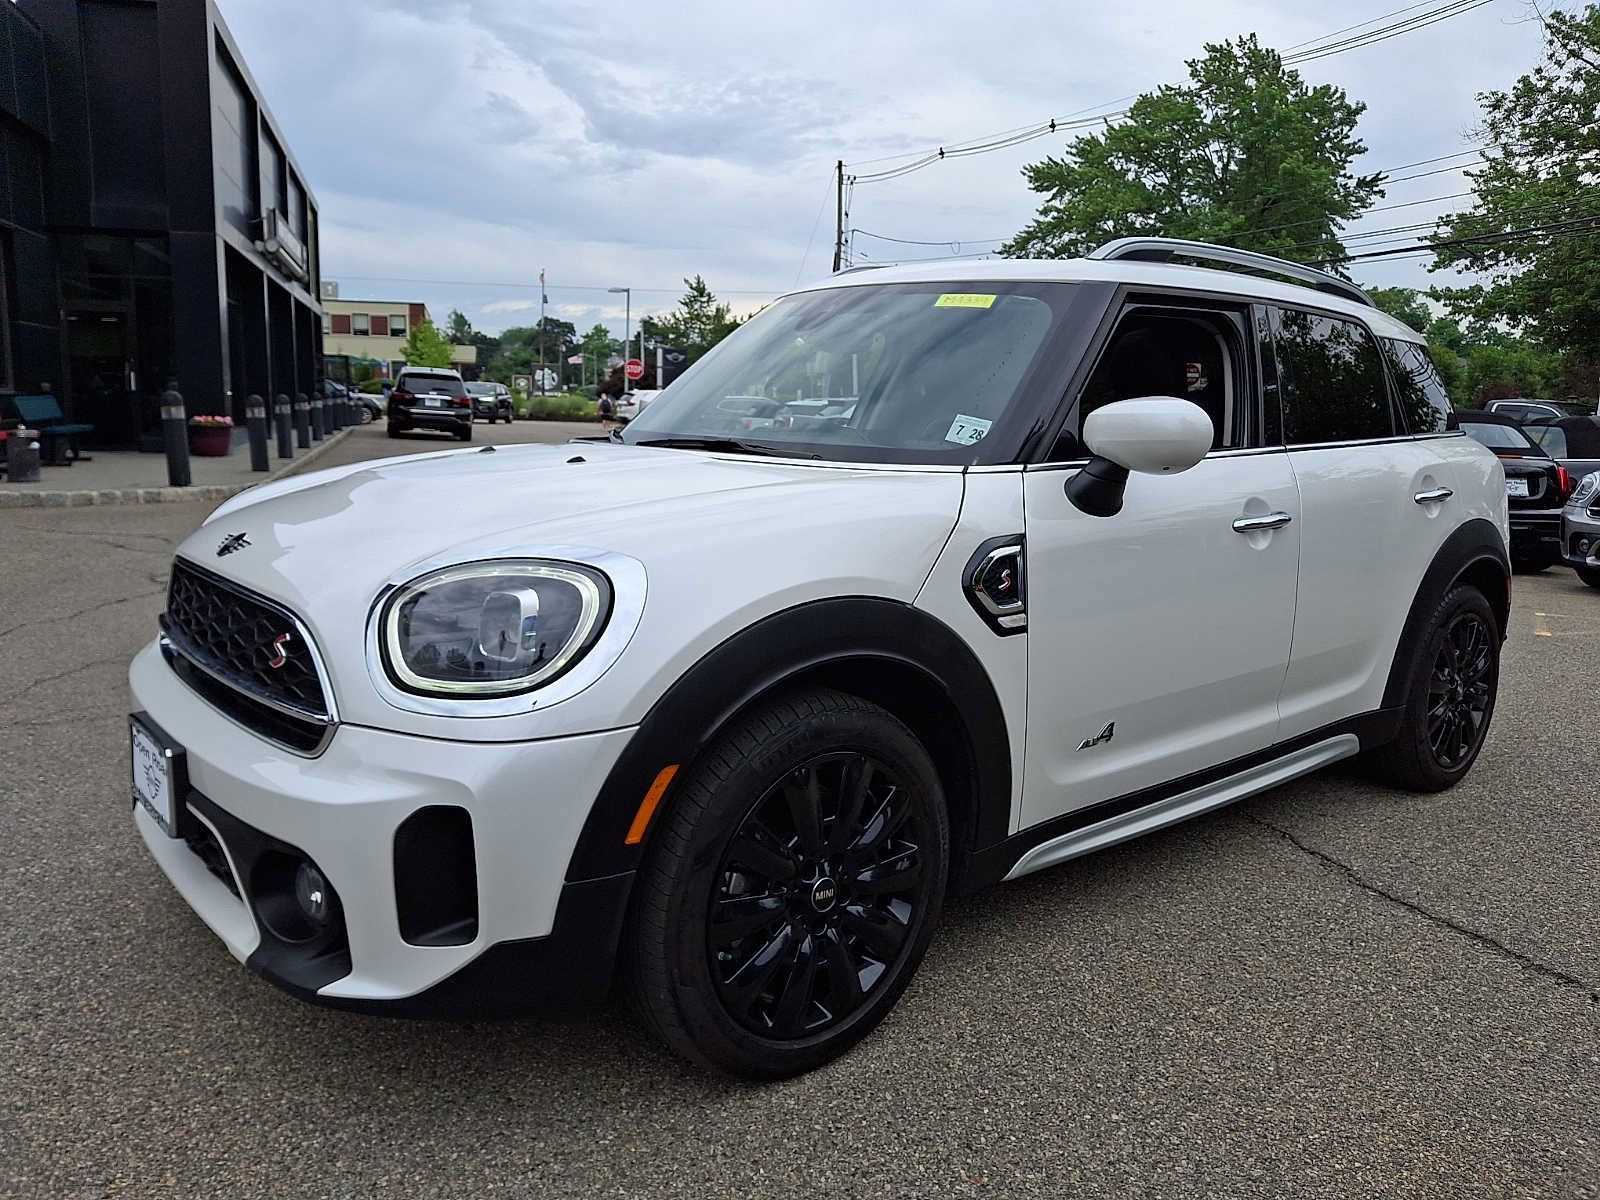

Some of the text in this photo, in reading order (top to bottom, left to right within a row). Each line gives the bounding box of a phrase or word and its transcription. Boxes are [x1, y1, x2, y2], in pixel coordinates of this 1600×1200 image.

[956, 424, 984, 440] 7 28
[268, 632, 291, 669] S
[815, 888, 834, 900] MINI
